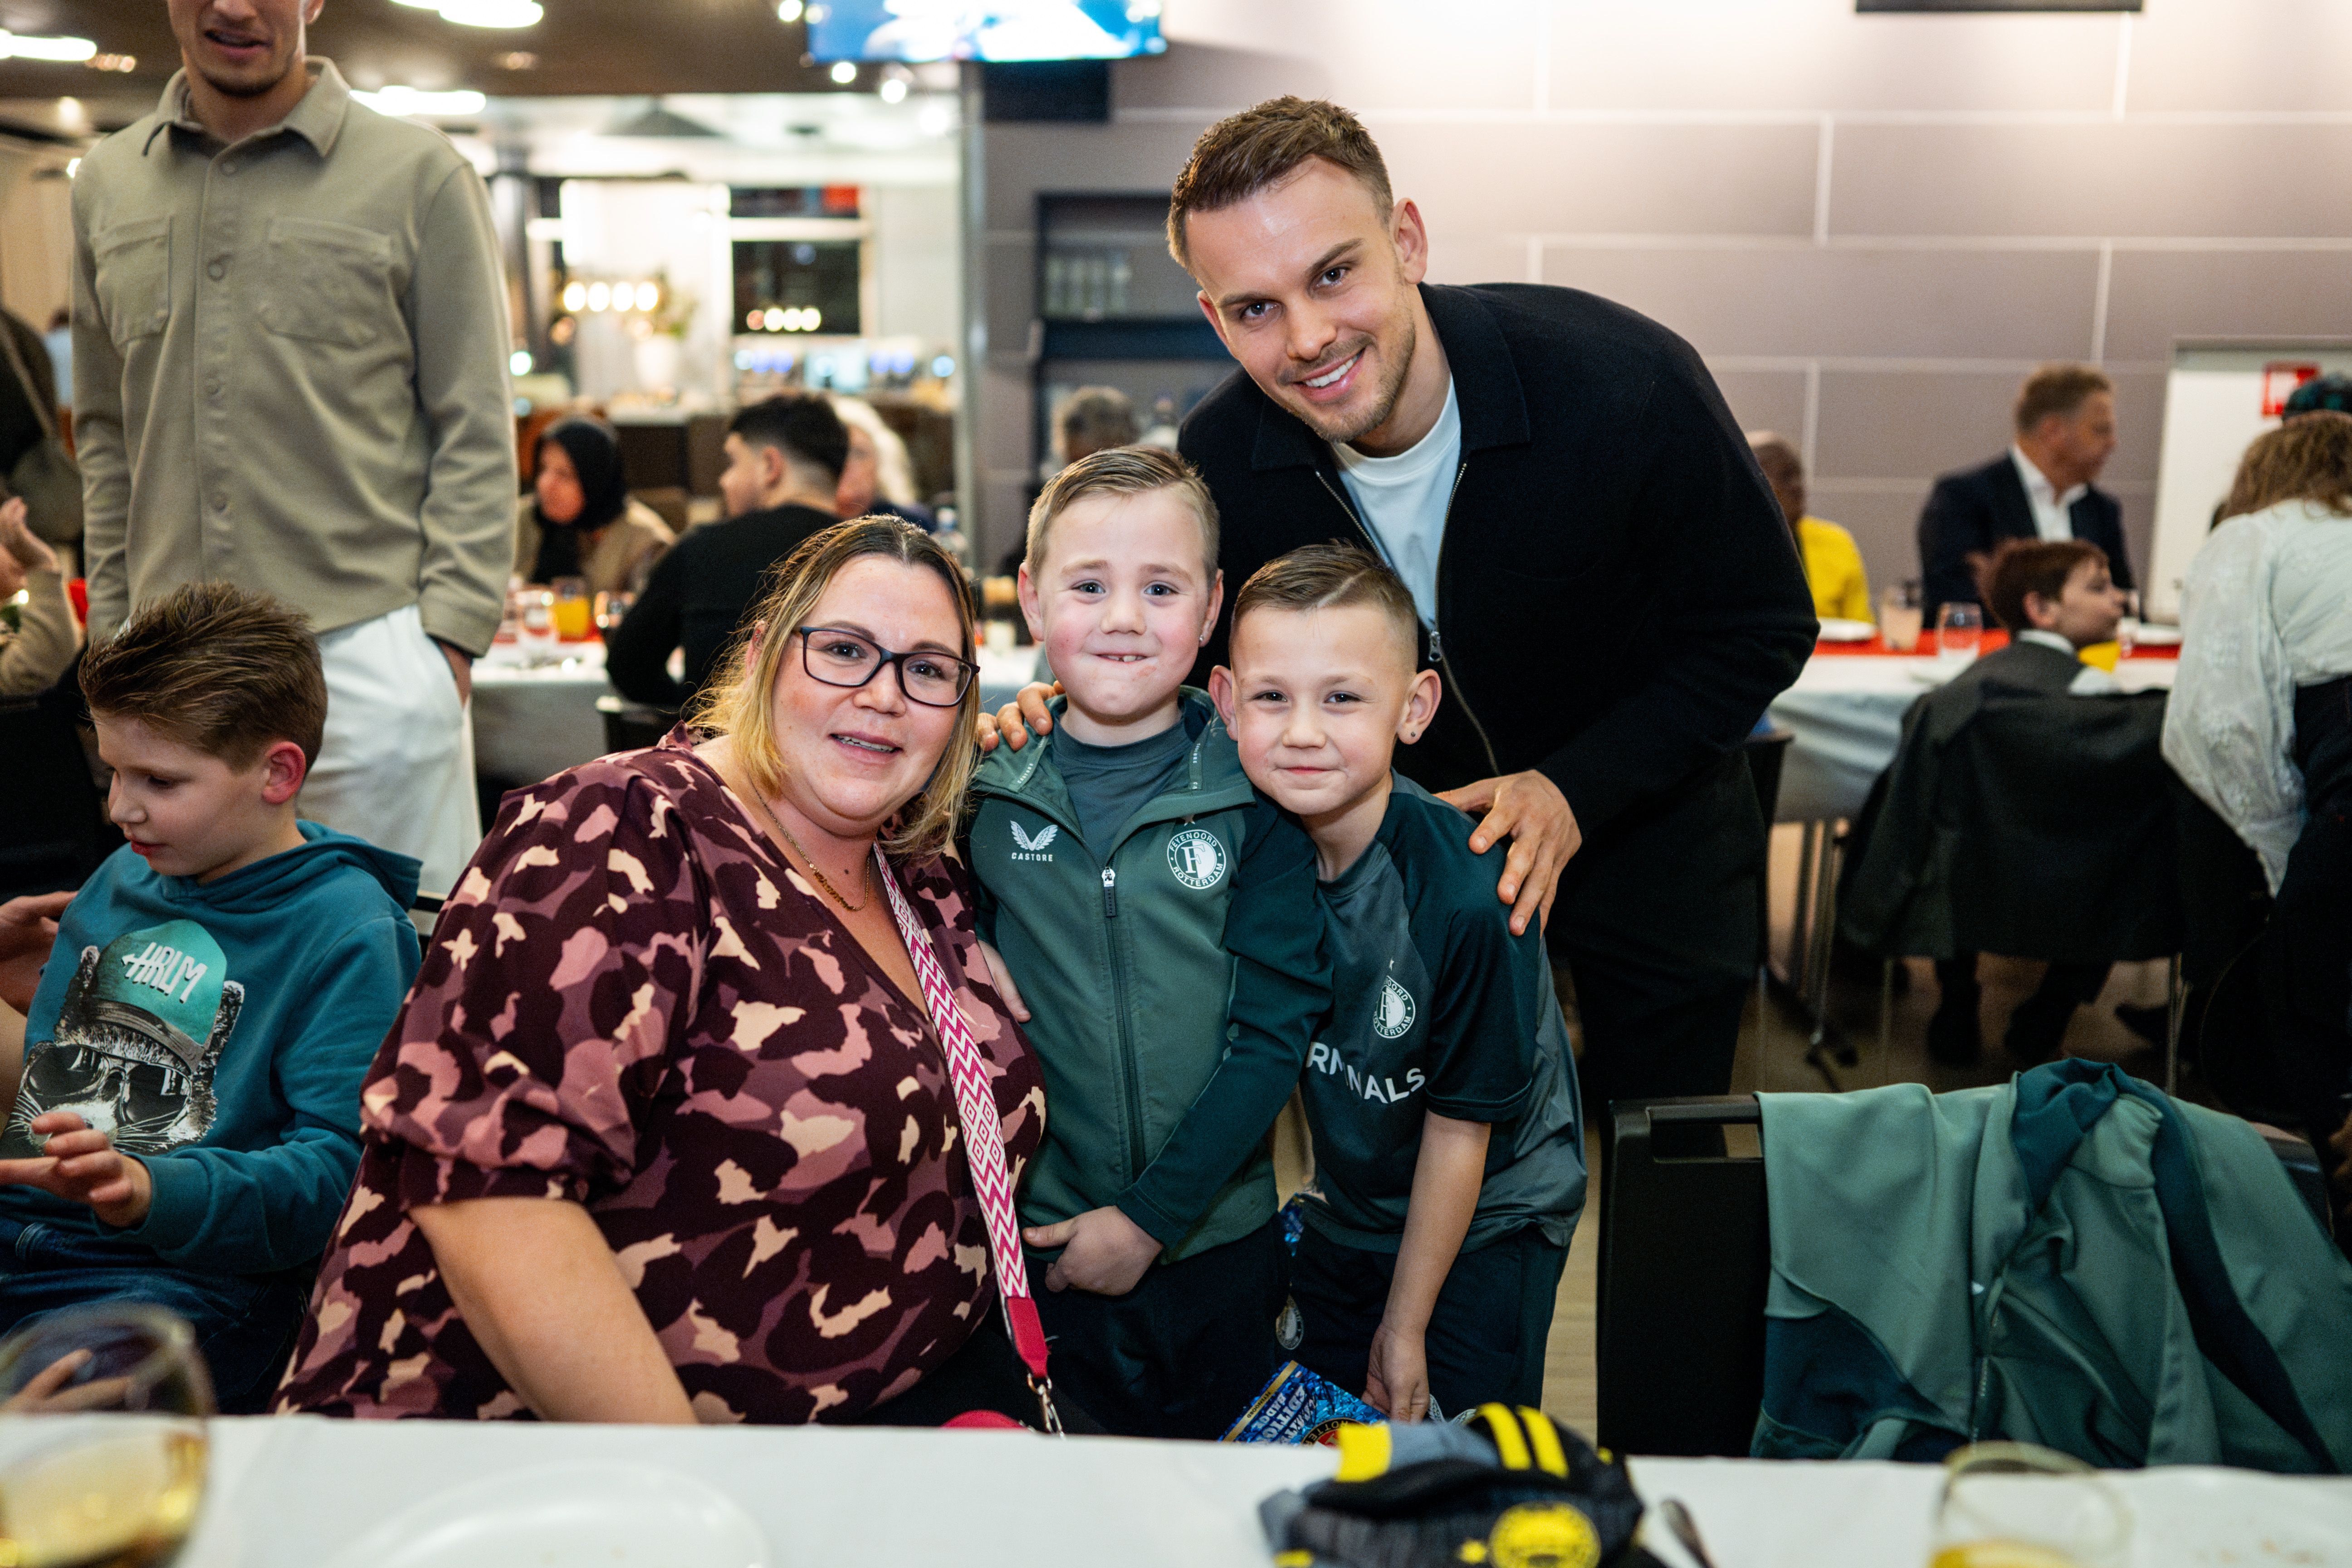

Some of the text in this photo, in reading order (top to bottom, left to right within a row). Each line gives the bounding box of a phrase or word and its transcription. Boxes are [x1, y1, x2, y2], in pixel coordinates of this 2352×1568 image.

[1170, 832, 1217, 852] FEYENOORD
[1011, 852, 1053, 862] CASTORE
[1173, 863, 1223, 887] ROTTERDAM
[1251, 1392, 1286, 1431] BADGE
